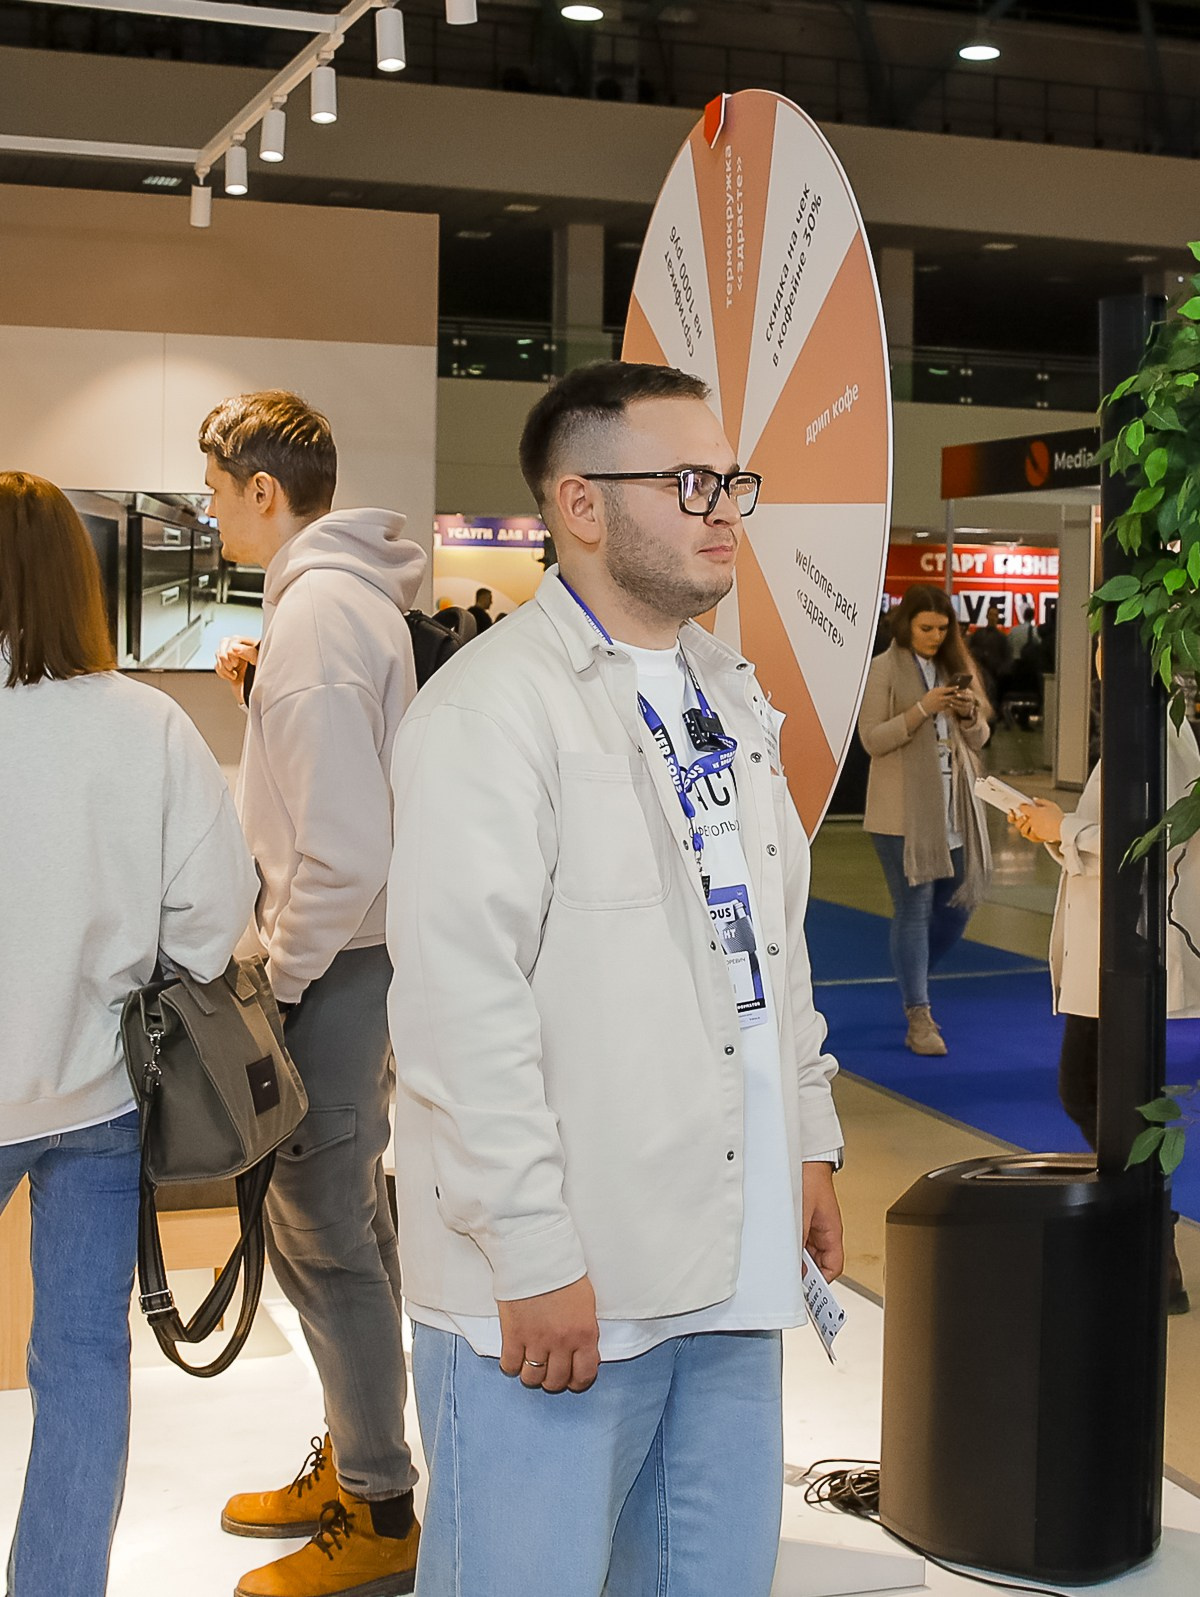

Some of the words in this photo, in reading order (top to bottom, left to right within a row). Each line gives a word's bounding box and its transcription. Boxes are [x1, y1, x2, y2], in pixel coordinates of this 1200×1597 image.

[669, 226, 684, 261] руб
[765, 263, 790, 343] скидка
[788, 230, 799, 260] на
[796, 182, 812, 225] чек
[664, 250, 695, 358] сертификат
[679, 262, 695, 314] 1000
[772, 353, 780, 368] в
[777, 250, 808, 349] кофейне
[803, 194, 823, 248] 30%
[693, 313, 703, 340] на
[805, 408, 831, 446] дрип
[831, 383, 859, 419] кофе
[795, 548, 858, 627] welcome-pack
[920, 552, 988, 574] СТАРТ
[796, 588, 845, 648] «здрасте»
